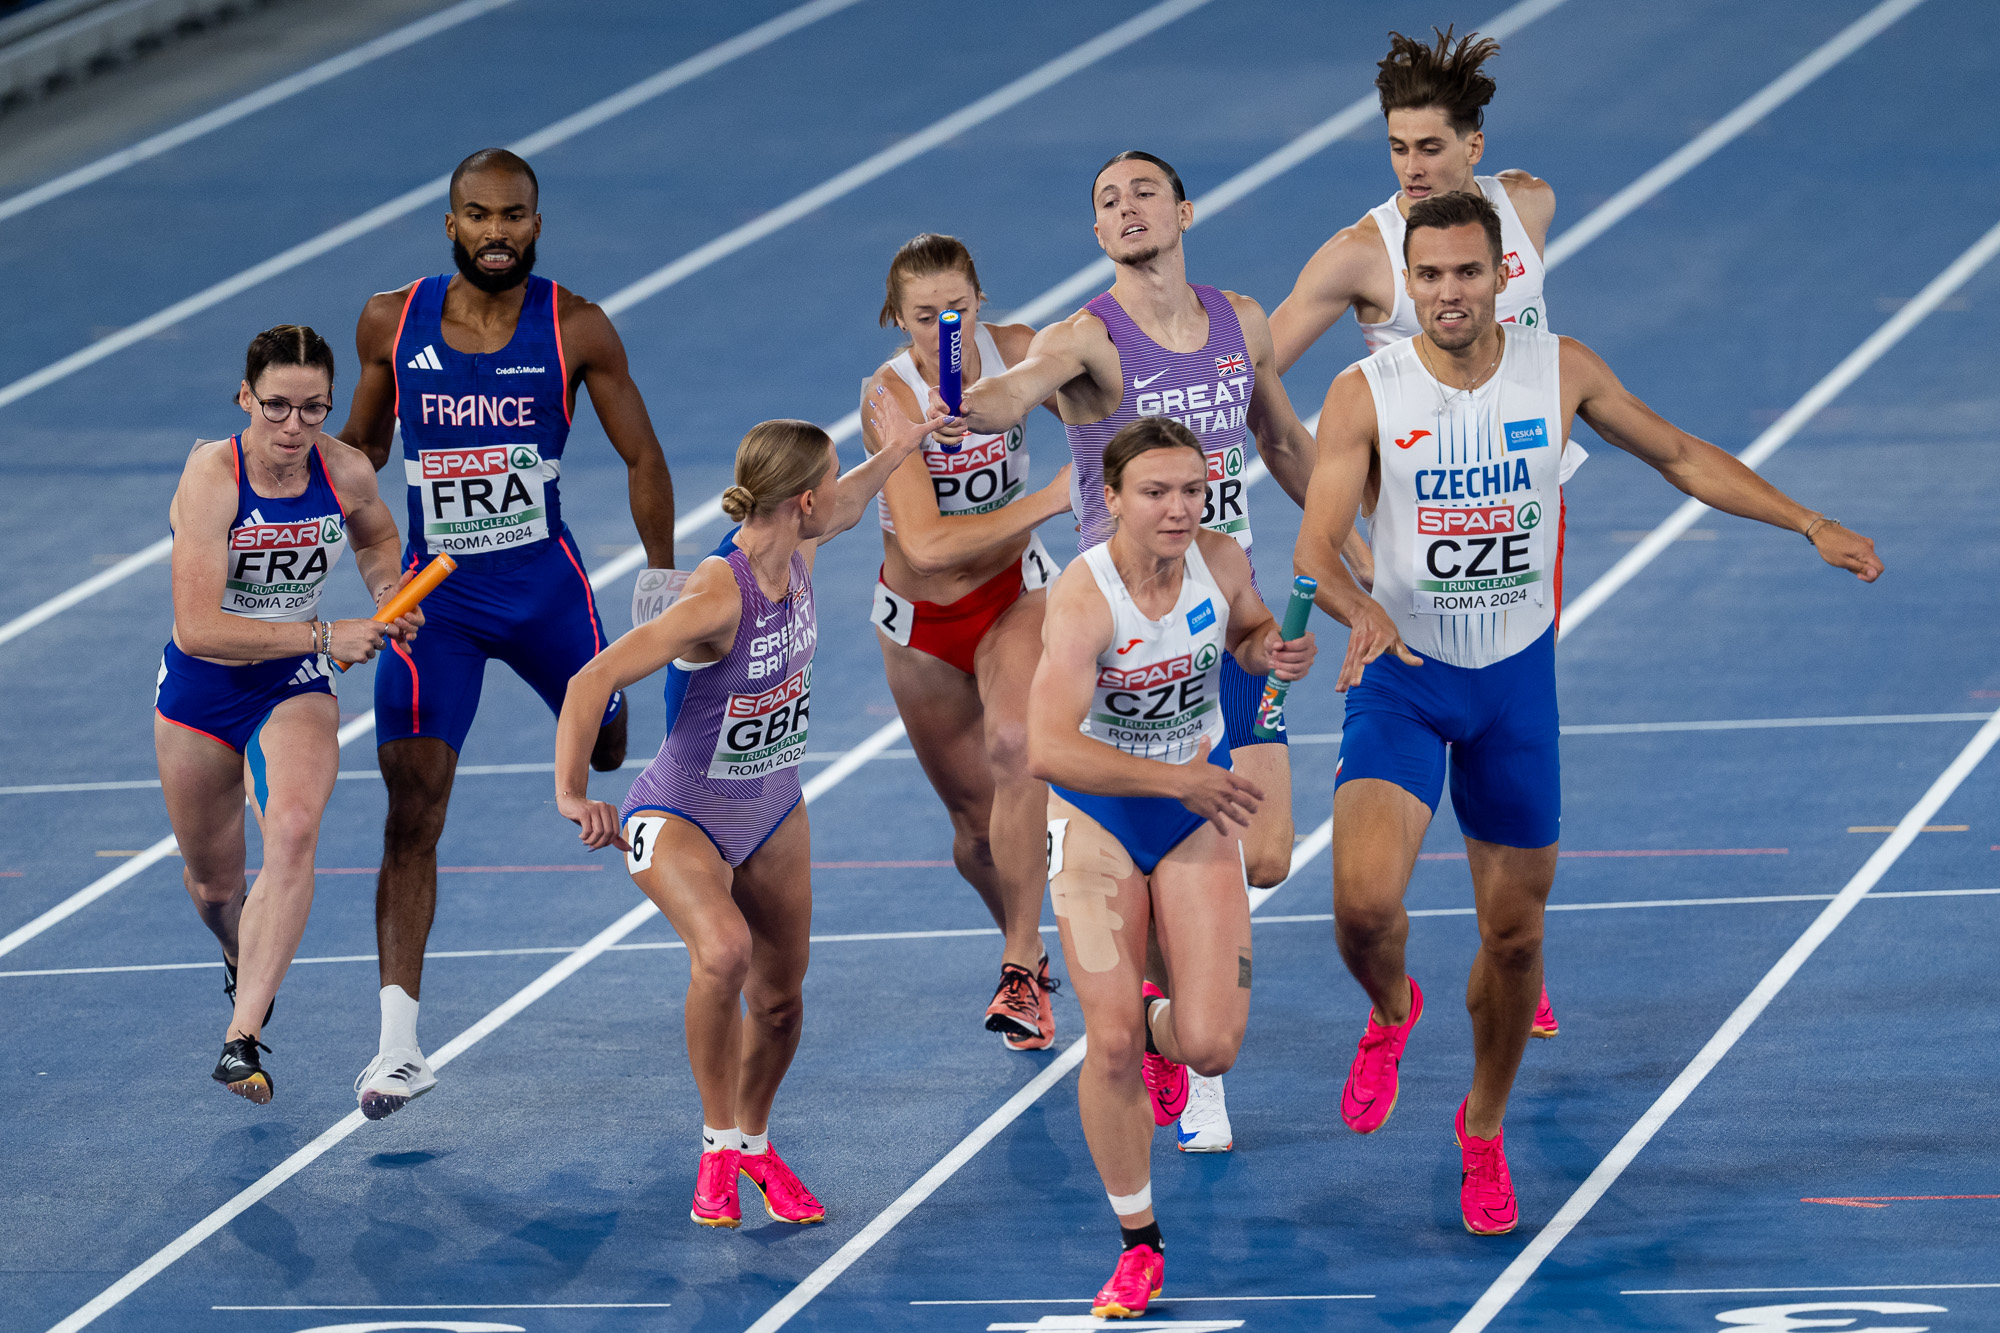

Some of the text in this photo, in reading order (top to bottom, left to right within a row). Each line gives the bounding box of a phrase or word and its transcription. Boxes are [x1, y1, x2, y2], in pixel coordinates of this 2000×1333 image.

[422, 393, 536, 427] FRANCE
[1136, 376, 1248, 416] GREAT
[424, 452, 506, 475] SPAR
[926, 440, 1004, 472] SPAR
[432, 472, 534, 519] FRA
[932, 460, 1019, 508] POL
[1415, 458, 1531, 500] CZECHIA
[1199, 479, 1243, 524] BR
[235, 527, 317, 547] SPAR
[455, 520, 480, 532] RUN
[1420, 509, 1512, 532] SPAR
[443, 526, 532, 550] ROMA 2024
[233, 547, 328, 583] FRA
[1426, 532, 1530, 579] CZE
[234, 591, 315, 608] ROMA 2024
[251, 584, 275, 594] RUN
[278, 583, 312, 593] CLEAN
[1434, 589, 1527, 609] ROMA 2024
[1448, 580, 1475, 591] RUN
[750, 600, 810, 657] GREAT
[882, 596, 898, 632] 2
[748, 623, 817, 679] BRITAIN
[1101, 660, 1190, 688] SPAR
[732, 676, 801, 715] SPAR
[1104, 672, 1207, 720] CZE
[727, 690, 810, 751] GBR
[1108, 720, 1203, 742] ROMA 2024
[1126, 720, 1153, 730] RUN
[728, 744, 806, 776] ROMA 2024
[747, 749, 769, 760] RUN
[632, 822, 647, 862] 6
